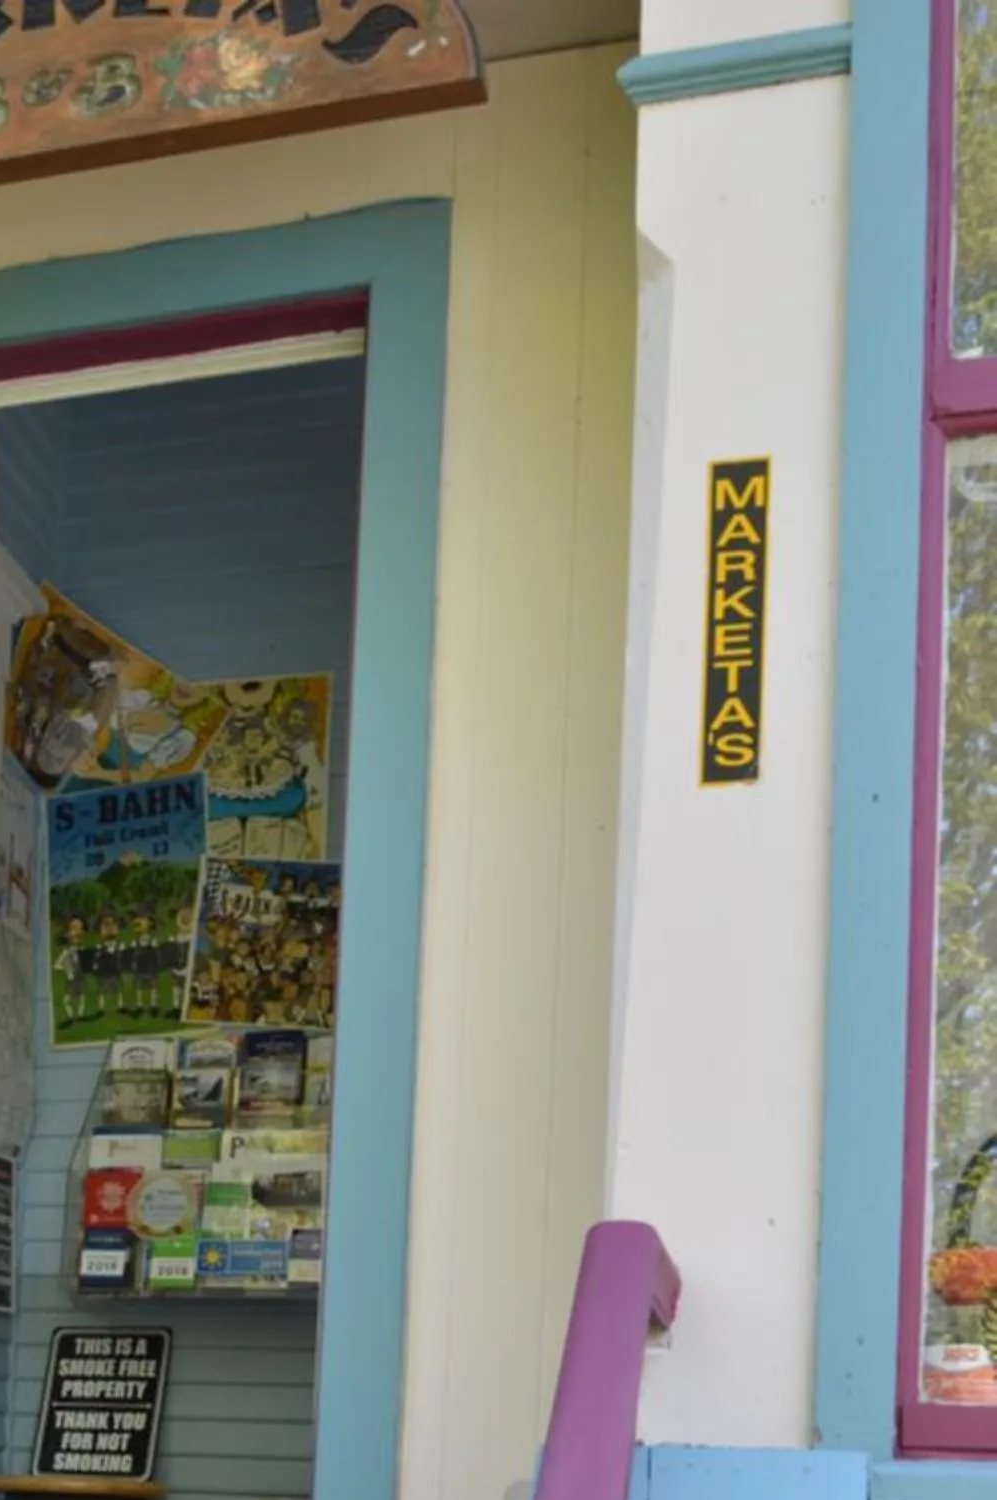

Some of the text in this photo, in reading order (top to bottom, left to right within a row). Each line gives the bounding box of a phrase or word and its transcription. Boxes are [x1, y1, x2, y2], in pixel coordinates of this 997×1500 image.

[74, 1338, 147, 1355] THIS IS A
[58, 1359, 157, 1377] SMOKE FREE
[61, 1380, 148, 1398] PROPERTY
[54, 1410, 147, 1430] THANK YOU
[61, 1432, 131, 1451] FOR NOT
[52, 1452, 134, 1472] SMOKING
